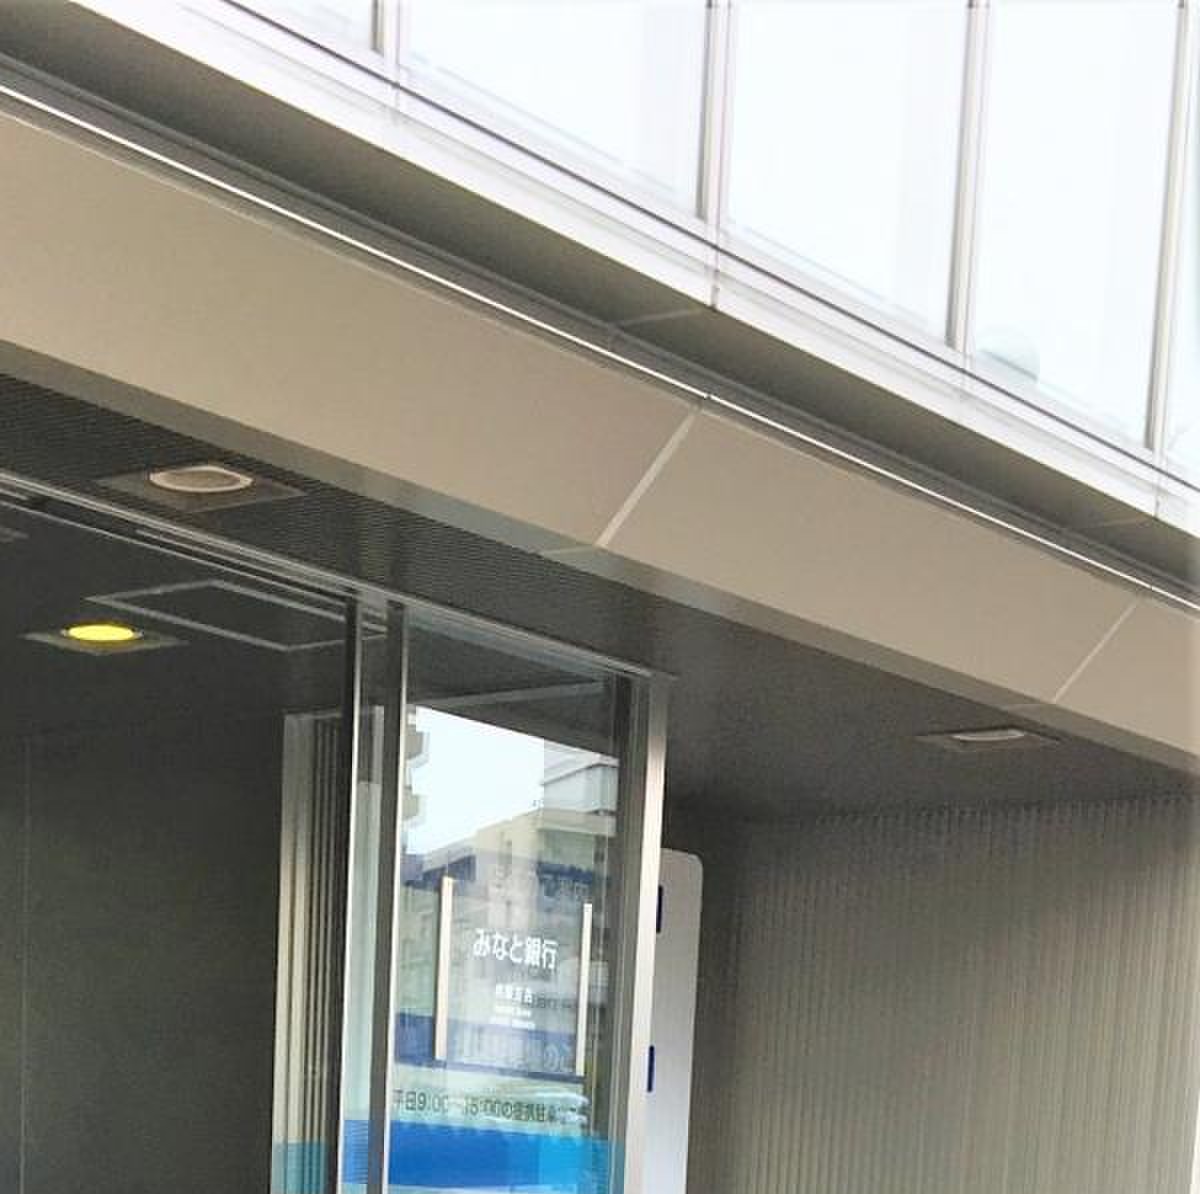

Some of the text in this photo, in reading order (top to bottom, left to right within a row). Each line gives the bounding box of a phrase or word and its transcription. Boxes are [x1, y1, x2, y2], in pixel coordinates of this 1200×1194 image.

[472, 927, 559, 970] みなと銀行
